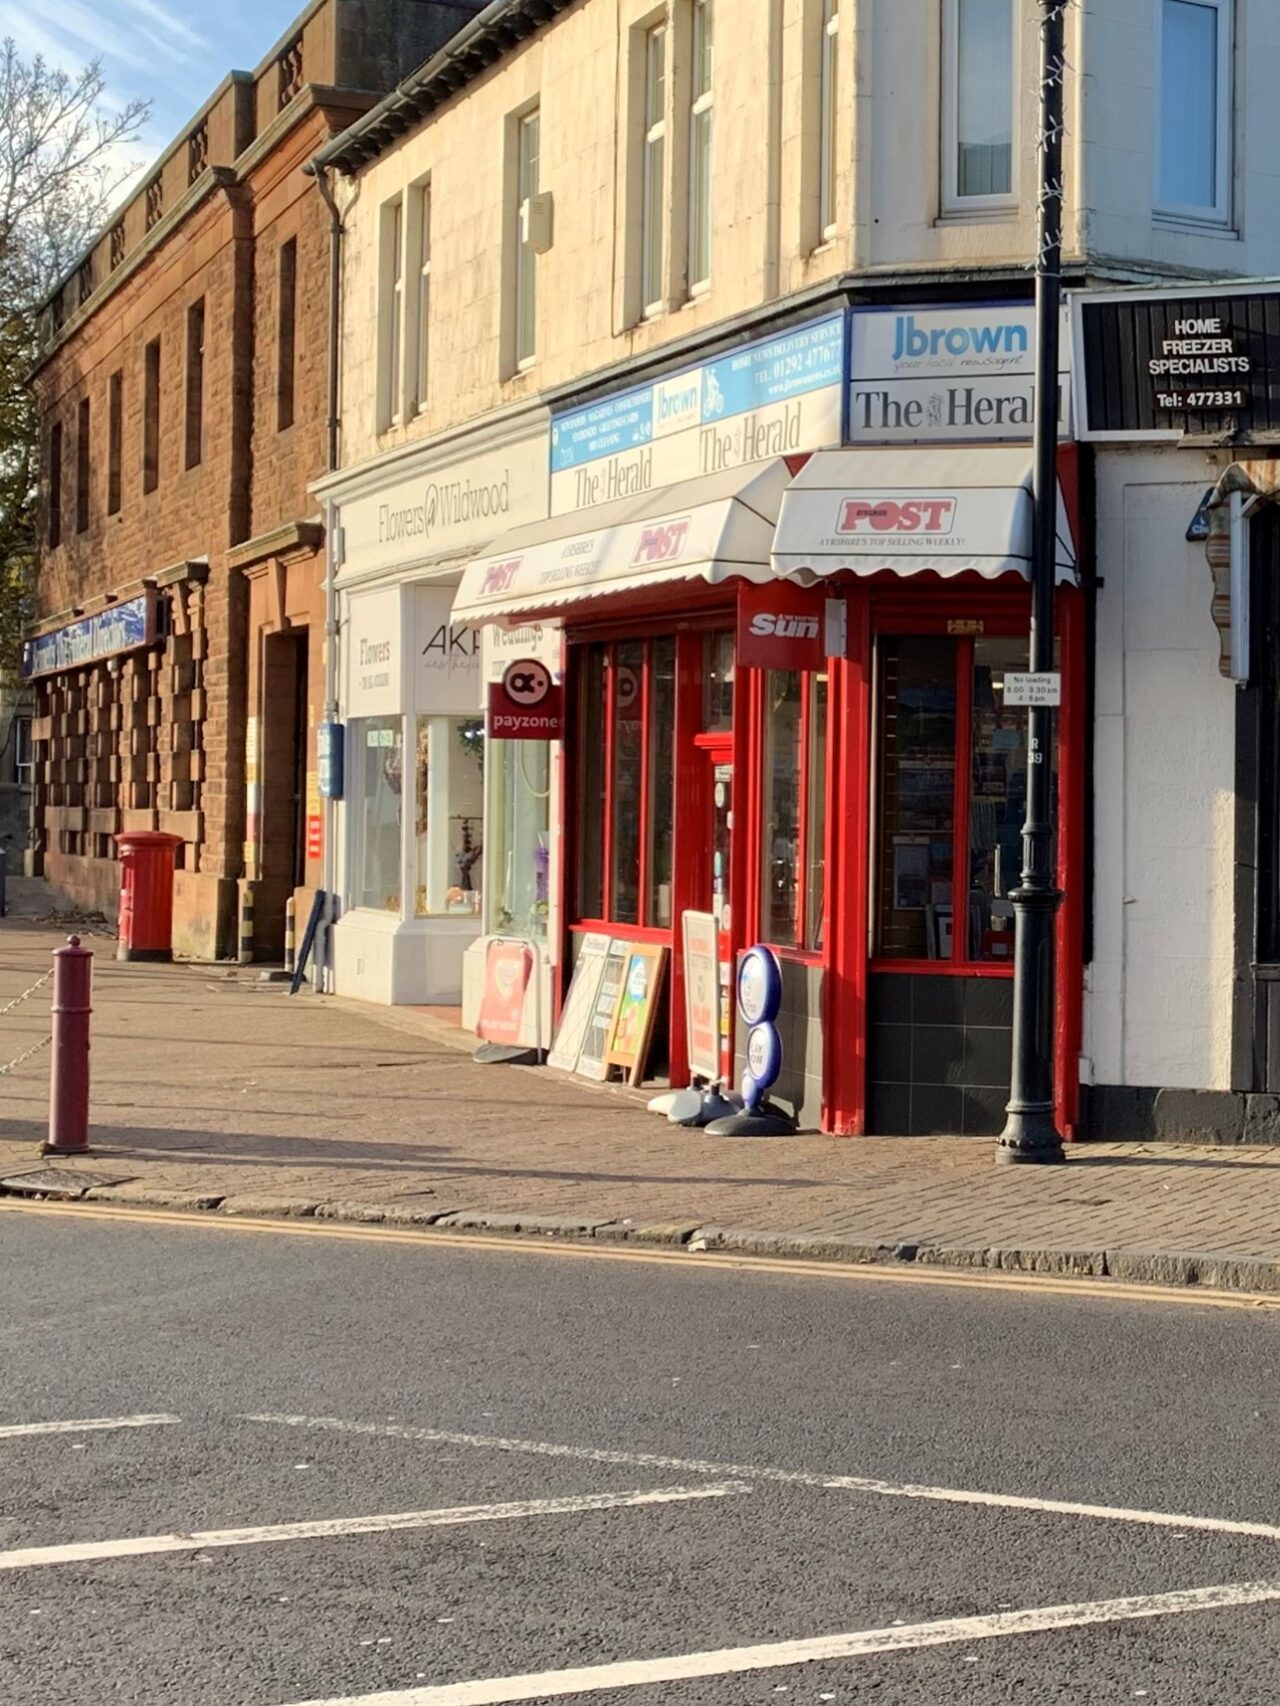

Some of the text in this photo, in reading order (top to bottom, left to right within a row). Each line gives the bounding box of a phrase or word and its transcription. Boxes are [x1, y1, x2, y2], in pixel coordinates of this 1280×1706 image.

[1174, 318, 1221, 335] HOME
[1162, 338, 1233, 355] FREEZER
[1148, 356, 1250, 375] SPECIALISTS
[855, 391, 923, 429] The
[1157, 390, 1241, 408] Tel: 477331
[701, 427, 732, 474] The
[741, 400, 802, 462] Herald
[575, 447, 652, 508] The Herald
[840, 501, 953, 532] POST
[632, 521, 689, 563] POST
[869, 536, 885, 547] TOP
[886, 536, 925, 547] SELLING
[926, 536, 966, 547] WEEKLY!
[478, 560, 522, 596] POST
[748, 612, 819, 638] Sun
[360, 638, 391, 667] Flowers
[493, 715, 558, 731] payzone
